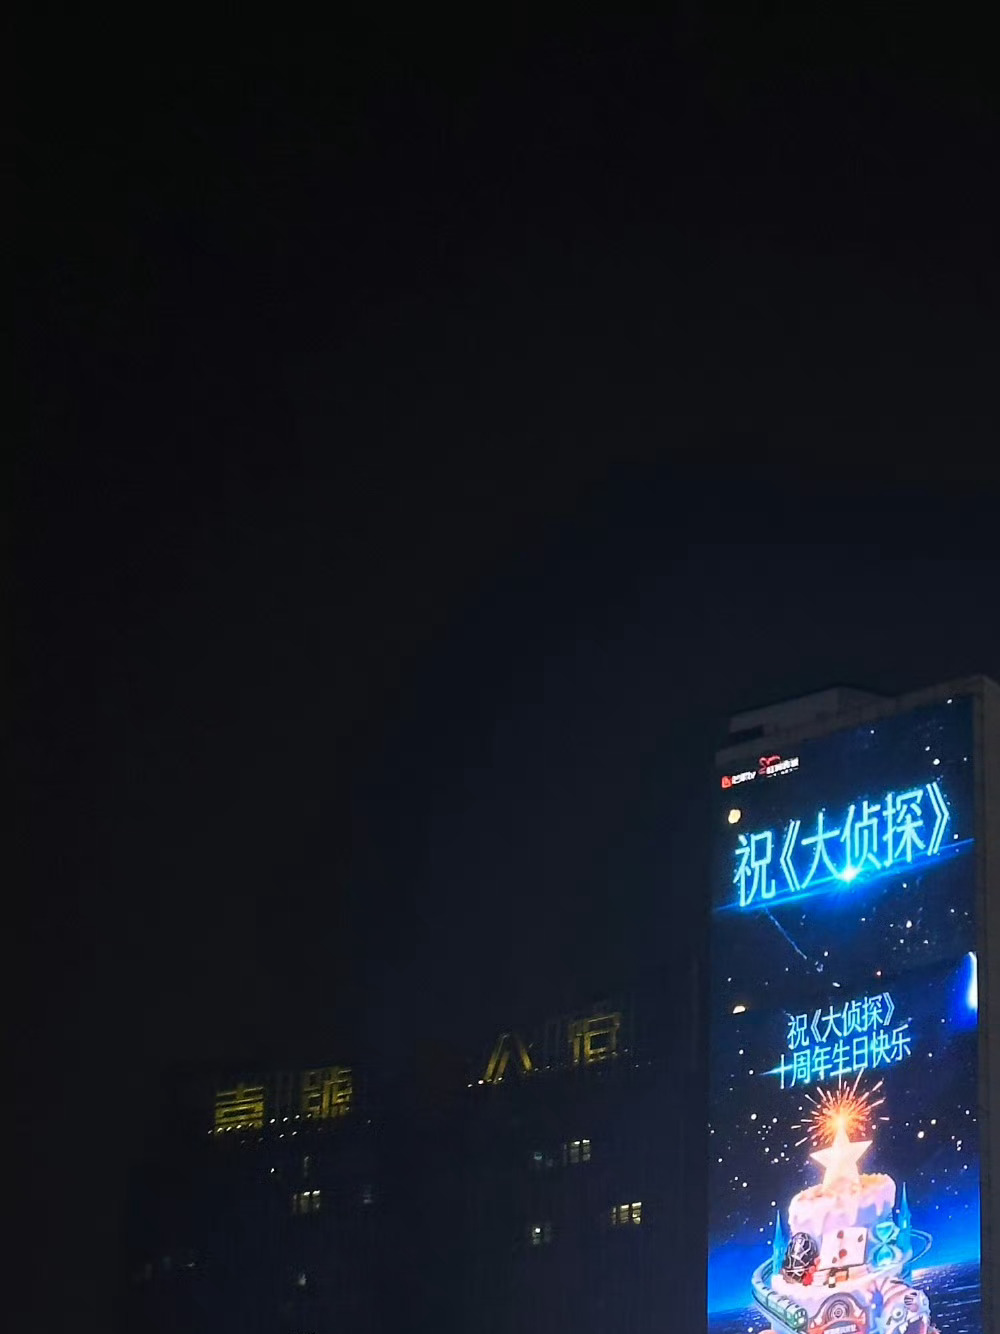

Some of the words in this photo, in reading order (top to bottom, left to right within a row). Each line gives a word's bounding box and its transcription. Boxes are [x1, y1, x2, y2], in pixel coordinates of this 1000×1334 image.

[733, 782, 949, 907] 祝《大侦探》
[787, 992, 895, 1049] 祝《大侦探》
[775, 1025, 911, 1090] 十周年生日快乐
